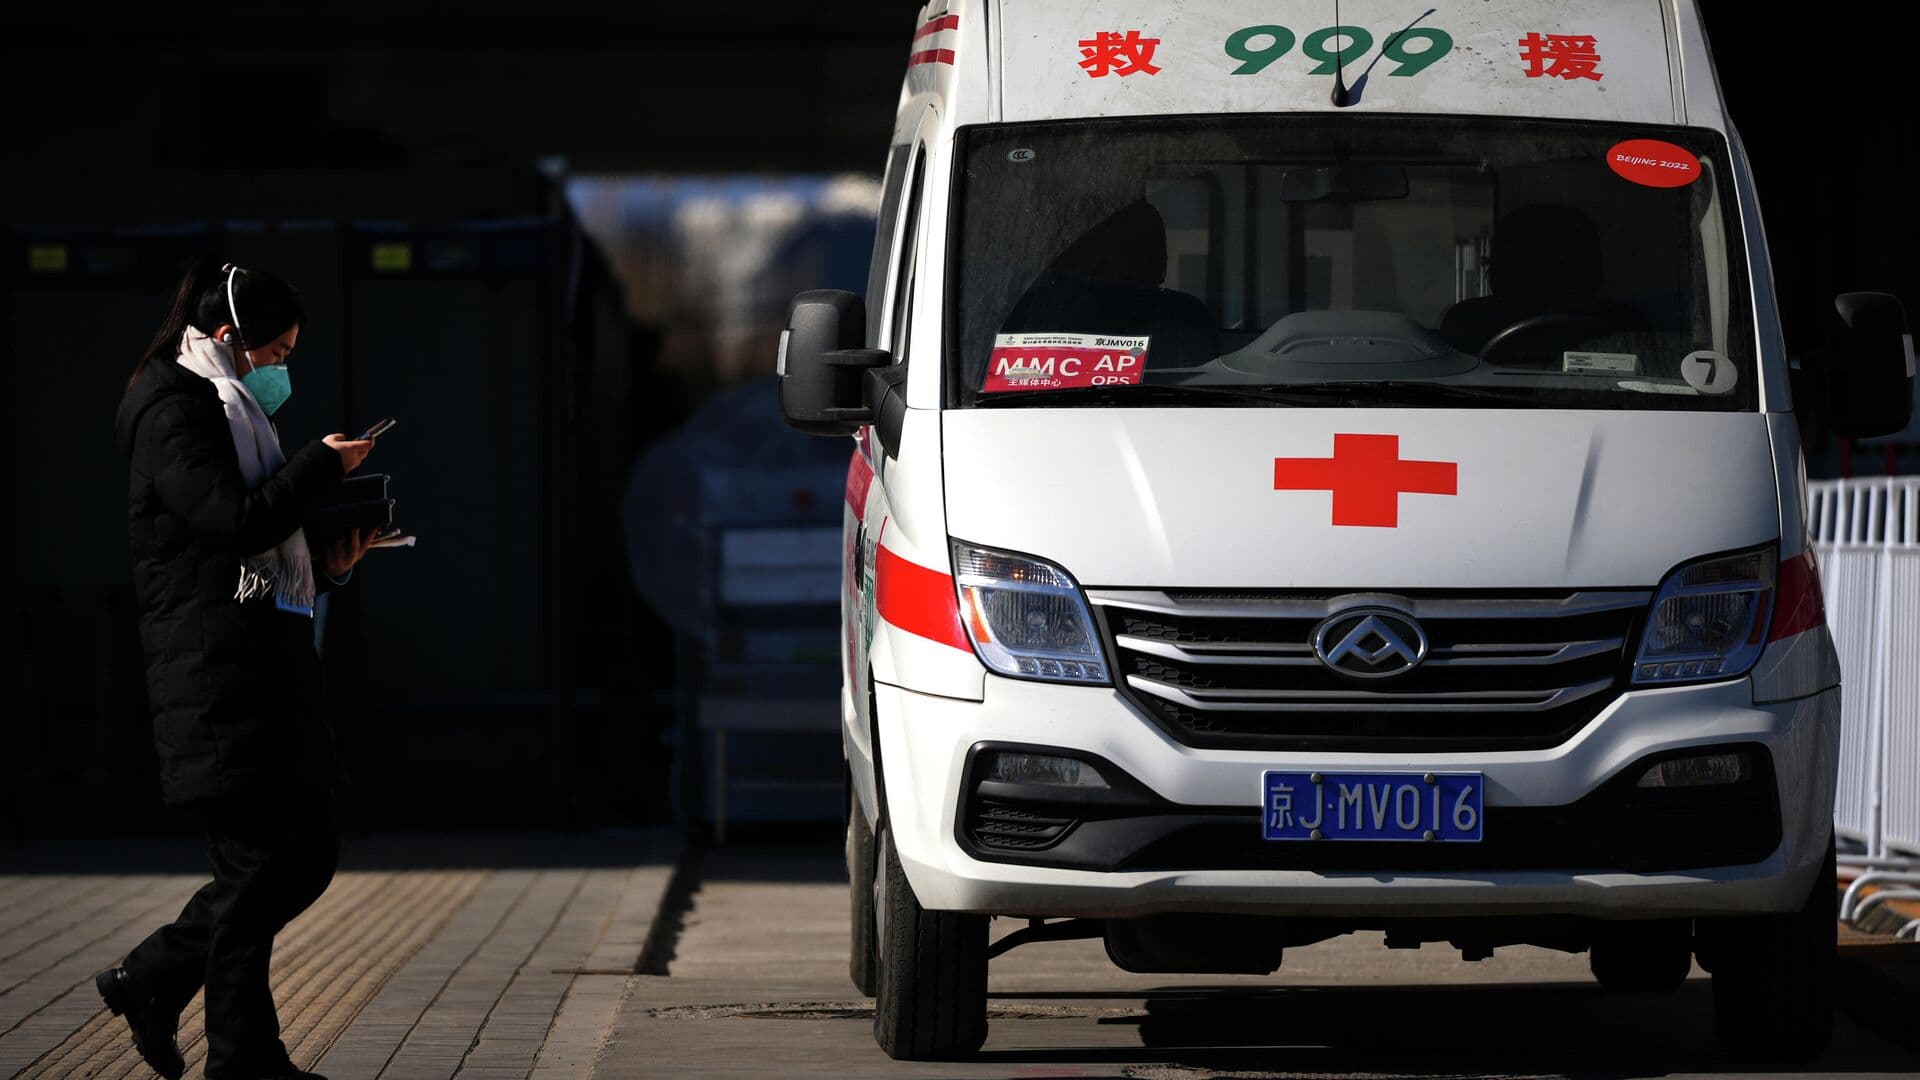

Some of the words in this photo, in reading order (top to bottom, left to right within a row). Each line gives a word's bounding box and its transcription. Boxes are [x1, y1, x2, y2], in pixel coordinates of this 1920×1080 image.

[1078, 31, 1162, 78] 救
[1224, 25, 1453, 76] 999
[1518, 32, 1604, 81] 援
[1616, 154, 1656, 166] BEIJING
[1660, 160, 1690, 170] 2022
[1094, 338, 1144, 347] 京JMV016
[995, 357, 1082, 377] MMC
[1093, 354, 1136, 372] AP
[1696, 358, 1716, 386] 7
[1007, 377, 1062, 387] 主媒体中心
[1091, 375, 1130, 386] OPS
